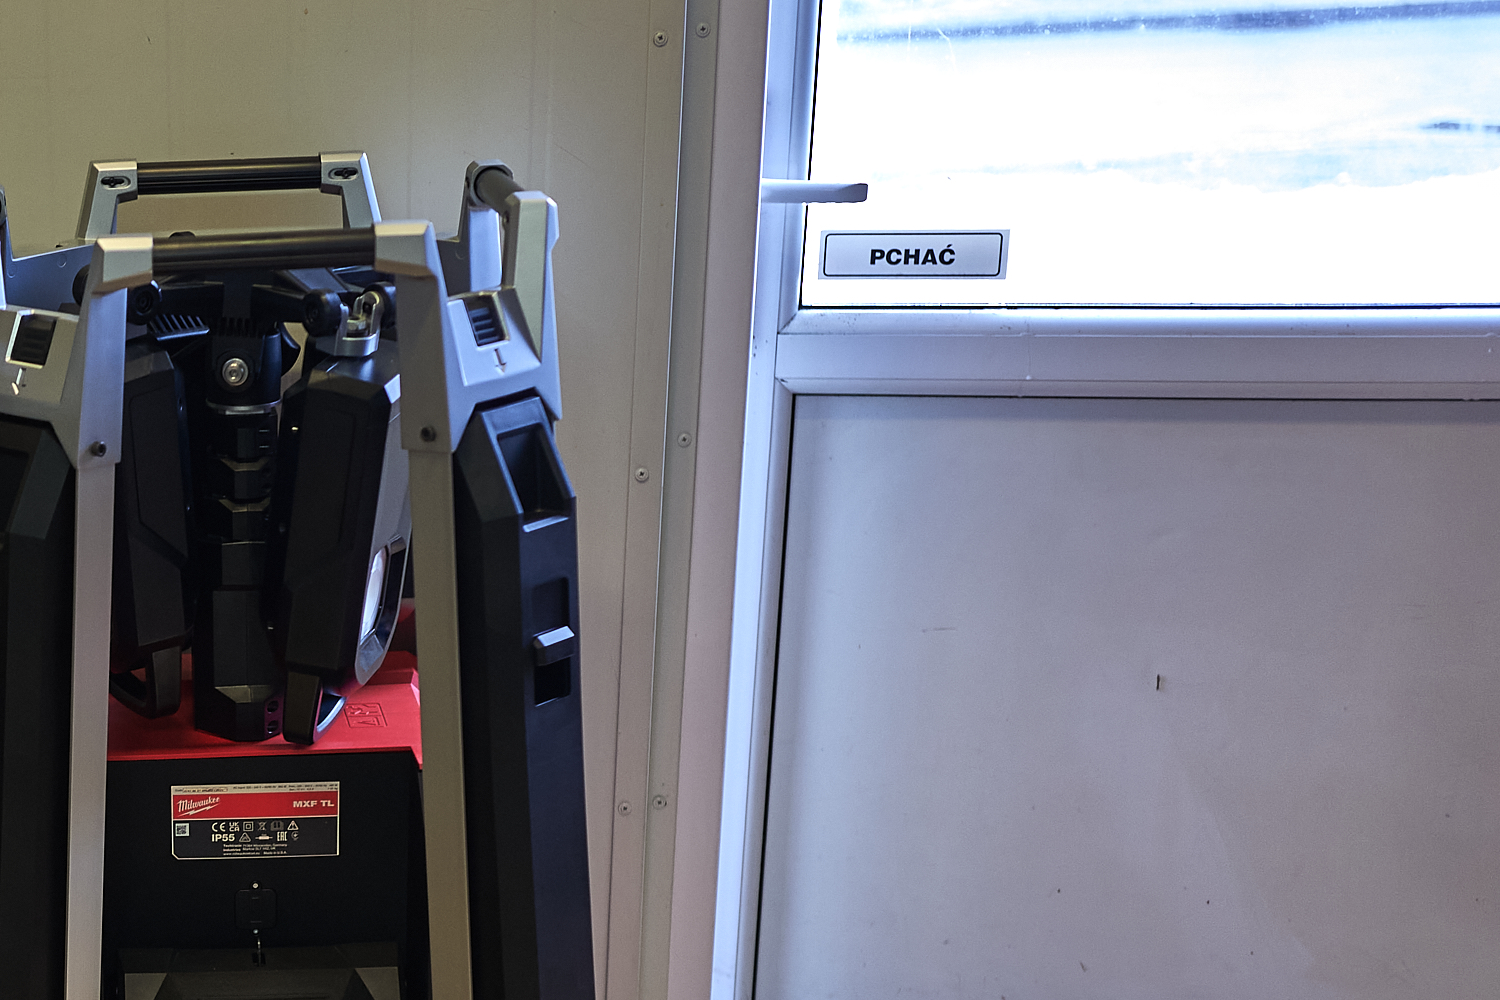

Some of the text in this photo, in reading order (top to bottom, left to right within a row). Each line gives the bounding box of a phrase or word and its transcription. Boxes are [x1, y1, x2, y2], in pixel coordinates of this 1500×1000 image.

[869, 243, 956, 265] PCHAĆ
[176, 796, 220, 812] Milwaukee
[293, 799, 335, 808] MXF TL
[211, 821, 226, 832] CE
[211, 833, 236, 842] IP55
